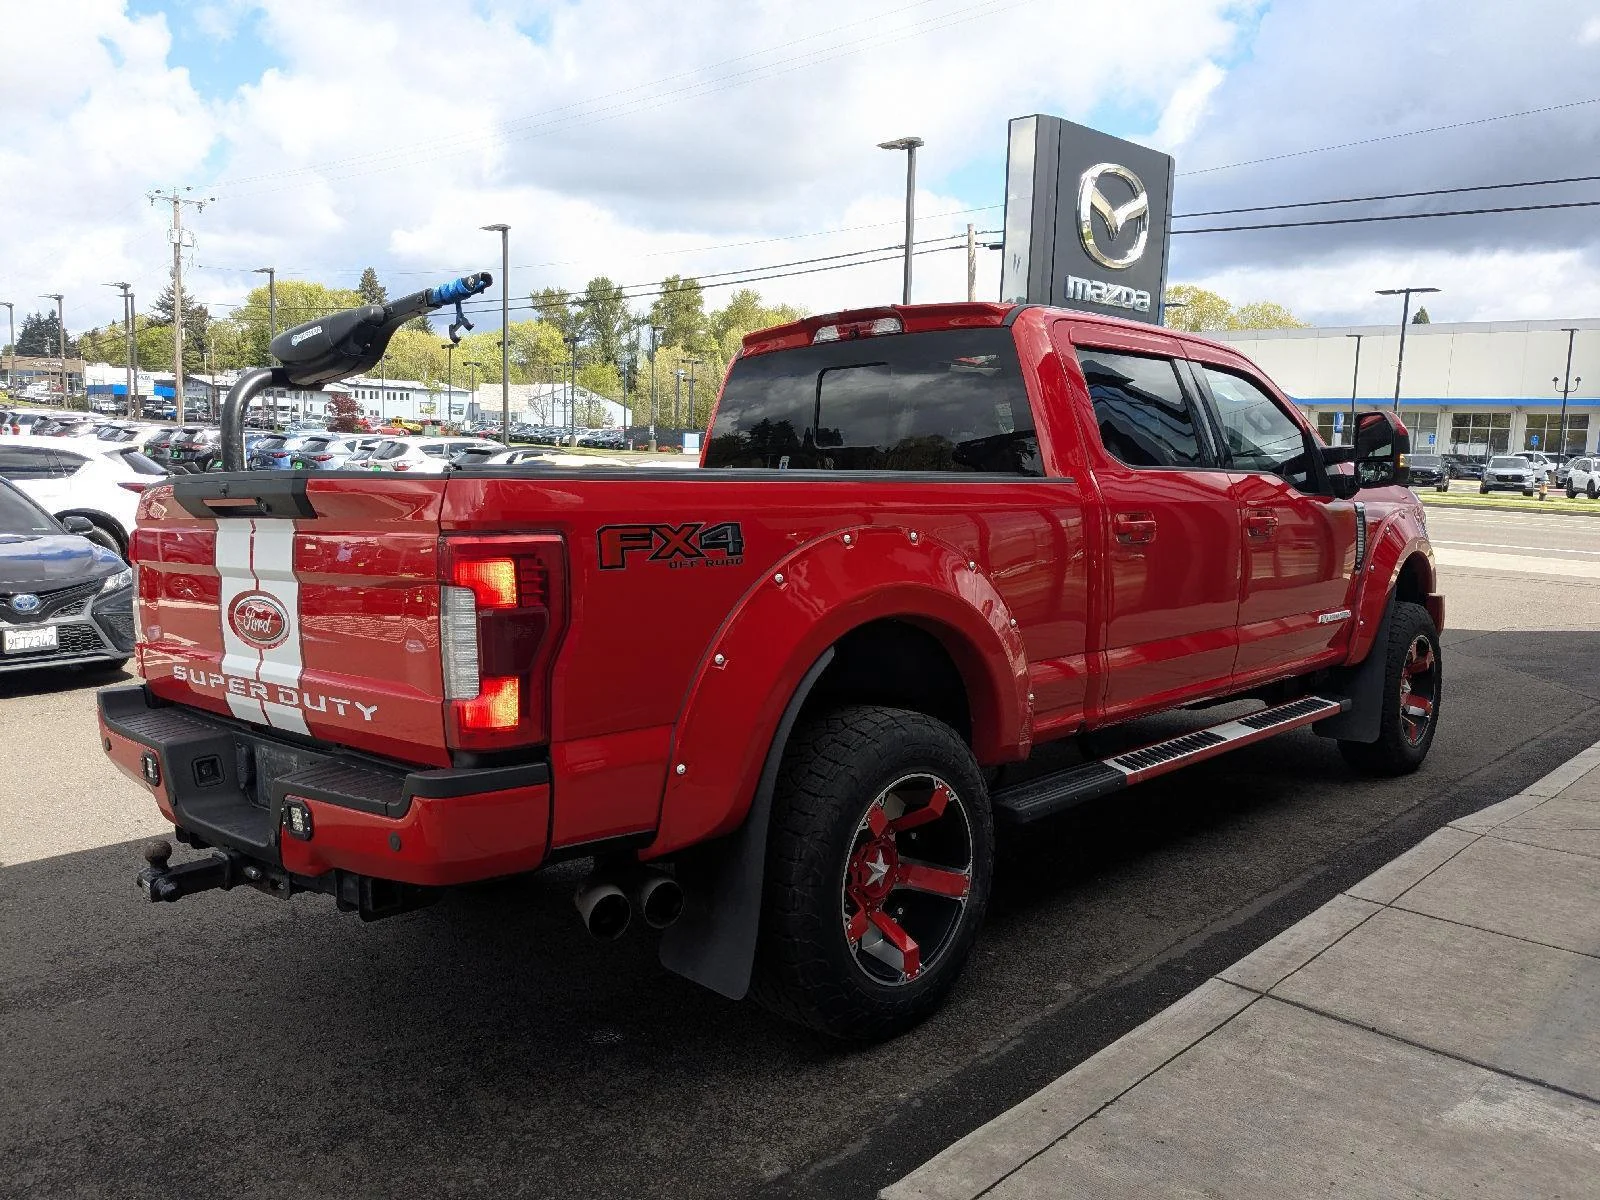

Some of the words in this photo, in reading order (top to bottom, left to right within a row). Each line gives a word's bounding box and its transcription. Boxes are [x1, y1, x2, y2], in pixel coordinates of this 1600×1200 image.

[1065, 275, 1151, 312] mazda
[596, 522, 745, 571] FX4
[669, 560, 698, 569] OFF
[705, 558, 744, 567] ROAD
[243, 605, 272, 635] Ford
[173, 664, 269, 700] SUPER
[277, 686, 379, 721] DUTY
